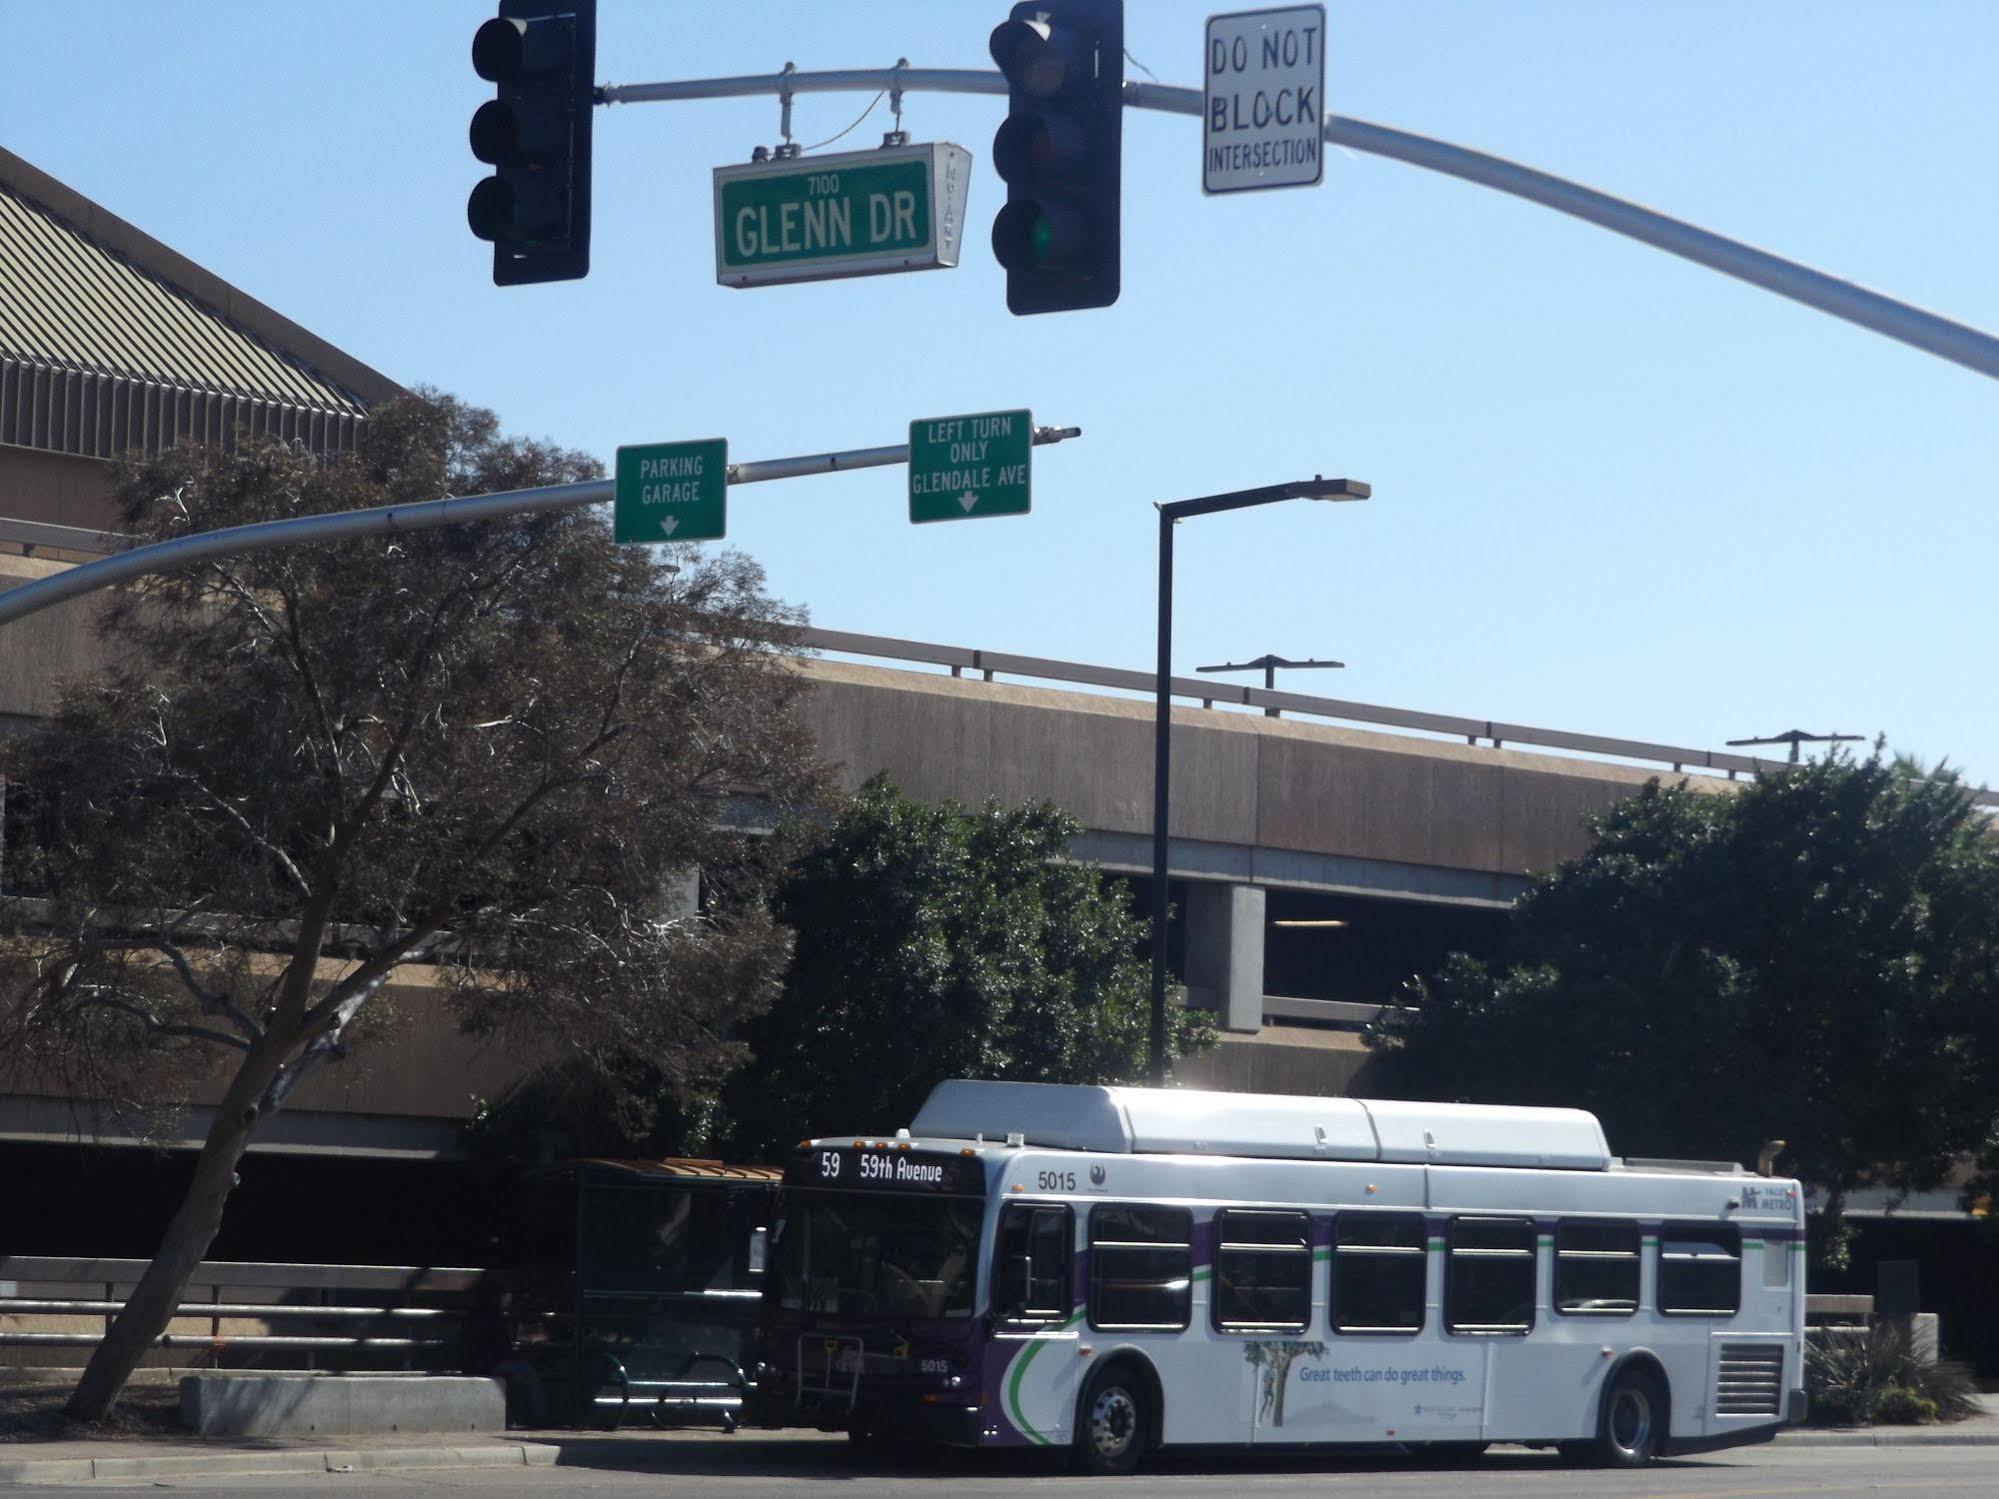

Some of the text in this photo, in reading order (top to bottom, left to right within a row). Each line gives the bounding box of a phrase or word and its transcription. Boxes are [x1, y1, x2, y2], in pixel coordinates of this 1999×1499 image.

[1212, 28, 1317, 74] DO NOT
[1211, 86, 1315, 132] BLOCK
[1209, 137, 1317, 171] INTERSECTION
[808, 174, 840, 195] 7100
[736, 190, 917, 257] GLENN DR
[928, 417, 1011, 443] LEFT TURN
[950, 441, 988, 463] ONLY
[640, 455, 703, 479] PARKING
[912, 464, 1026, 494] GLENDALE AVE
[642, 481, 700, 504] GARAGE
[821, 1151, 840, 1177] 59
[860, 1153, 942, 1182] 59th Avenue
[1038, 1171, 1076, 1191] 5015
[1762, 1199, 1792, 1210] METRO
[920, 1360, 948, 1373] 5015
[1300, 1367, 1330, 1382] Great
[1333, 1366, 1362, 1382] teeth
[1363, 1368, 1382, 1382] can
[1384, 1366, 1398, 1382] do
[1400, 1368, 1428, 1385] great
